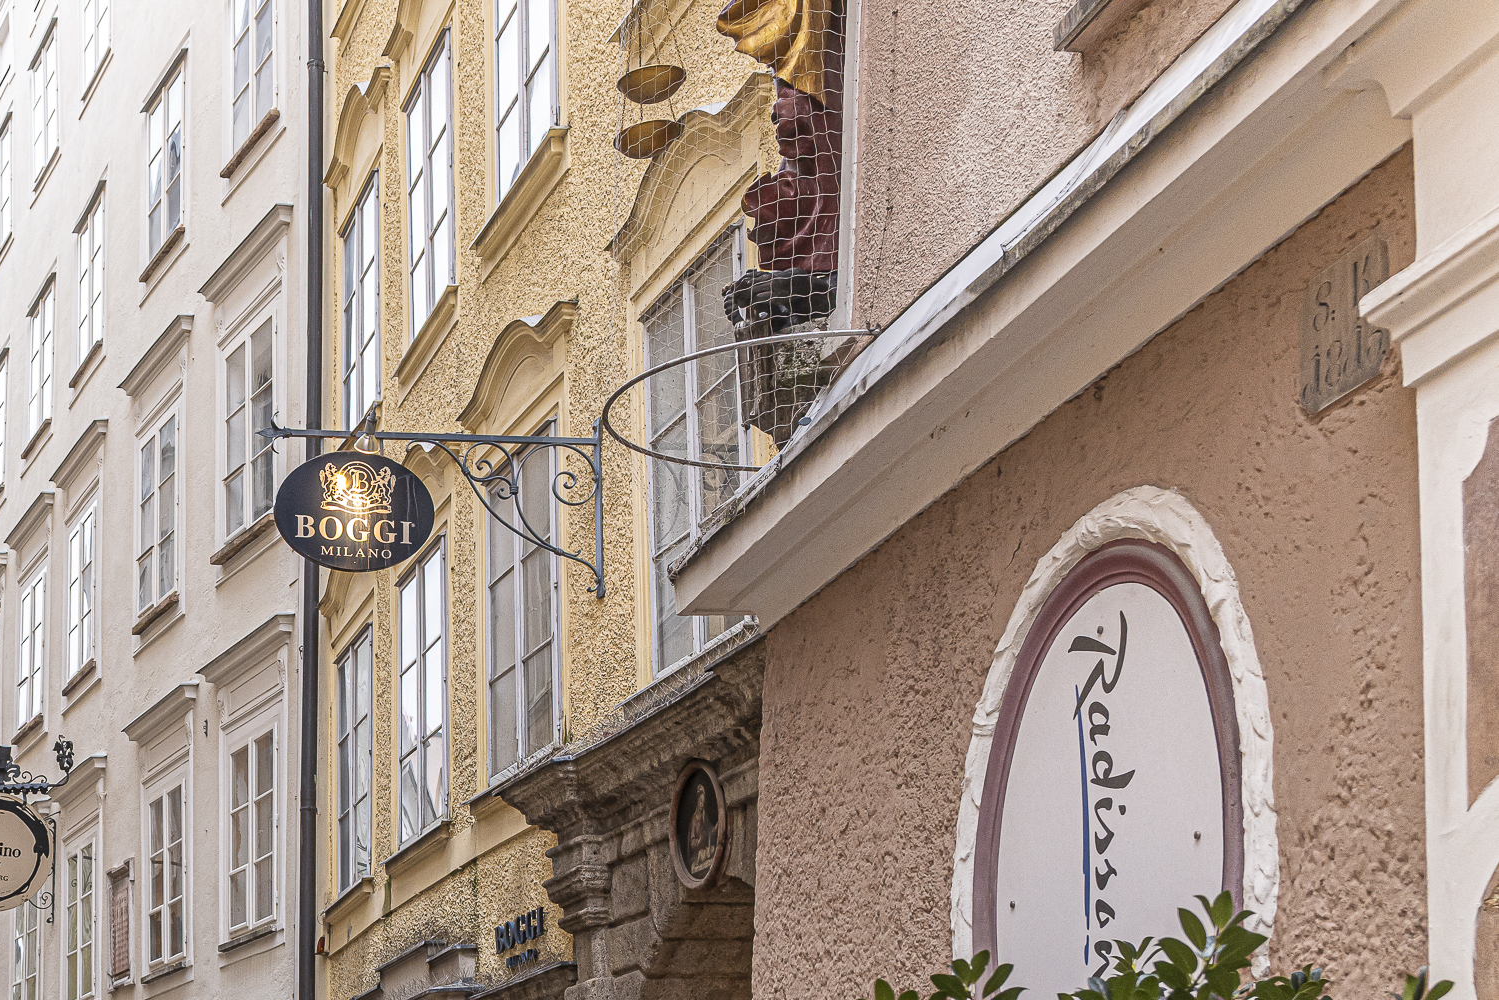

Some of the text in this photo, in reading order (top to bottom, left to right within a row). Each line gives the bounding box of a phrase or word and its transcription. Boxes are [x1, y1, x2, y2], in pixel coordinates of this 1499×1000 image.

[295, 514, 413, 545] BOGGI
[320, 545, 392, 560] MILANO
[494, 906, 544, 954] BOGGI
